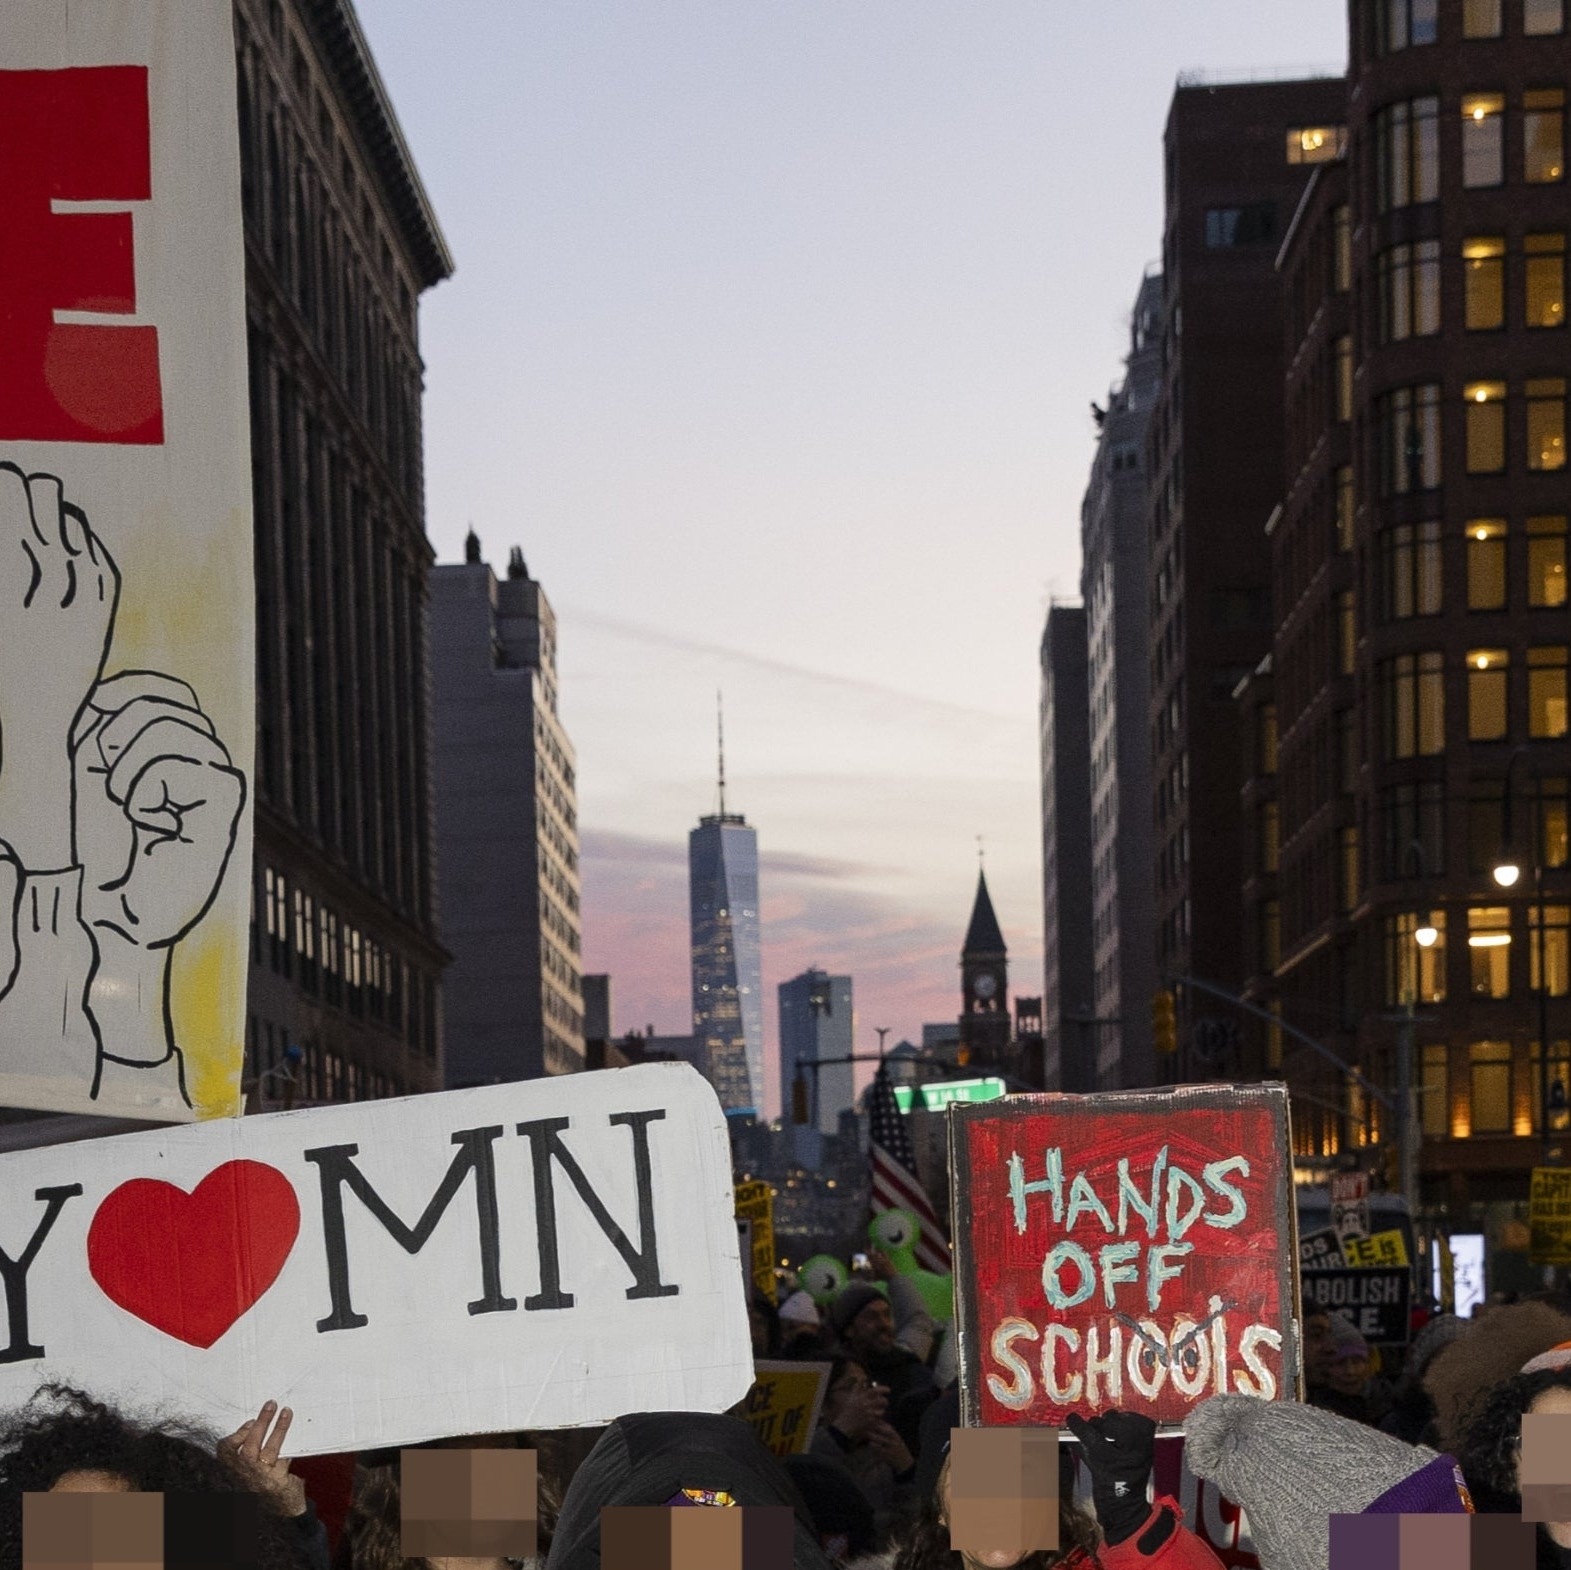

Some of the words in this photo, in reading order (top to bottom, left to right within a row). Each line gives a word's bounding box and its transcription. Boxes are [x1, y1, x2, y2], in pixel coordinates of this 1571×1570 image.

[304, 1110, 678, 1333] MN
[1007, 1146, 1250, 1241] HANDS
[1041, 1241, 1194, 1312] OFF
[1302, 1275, 1401, 1305] ABOLISH
